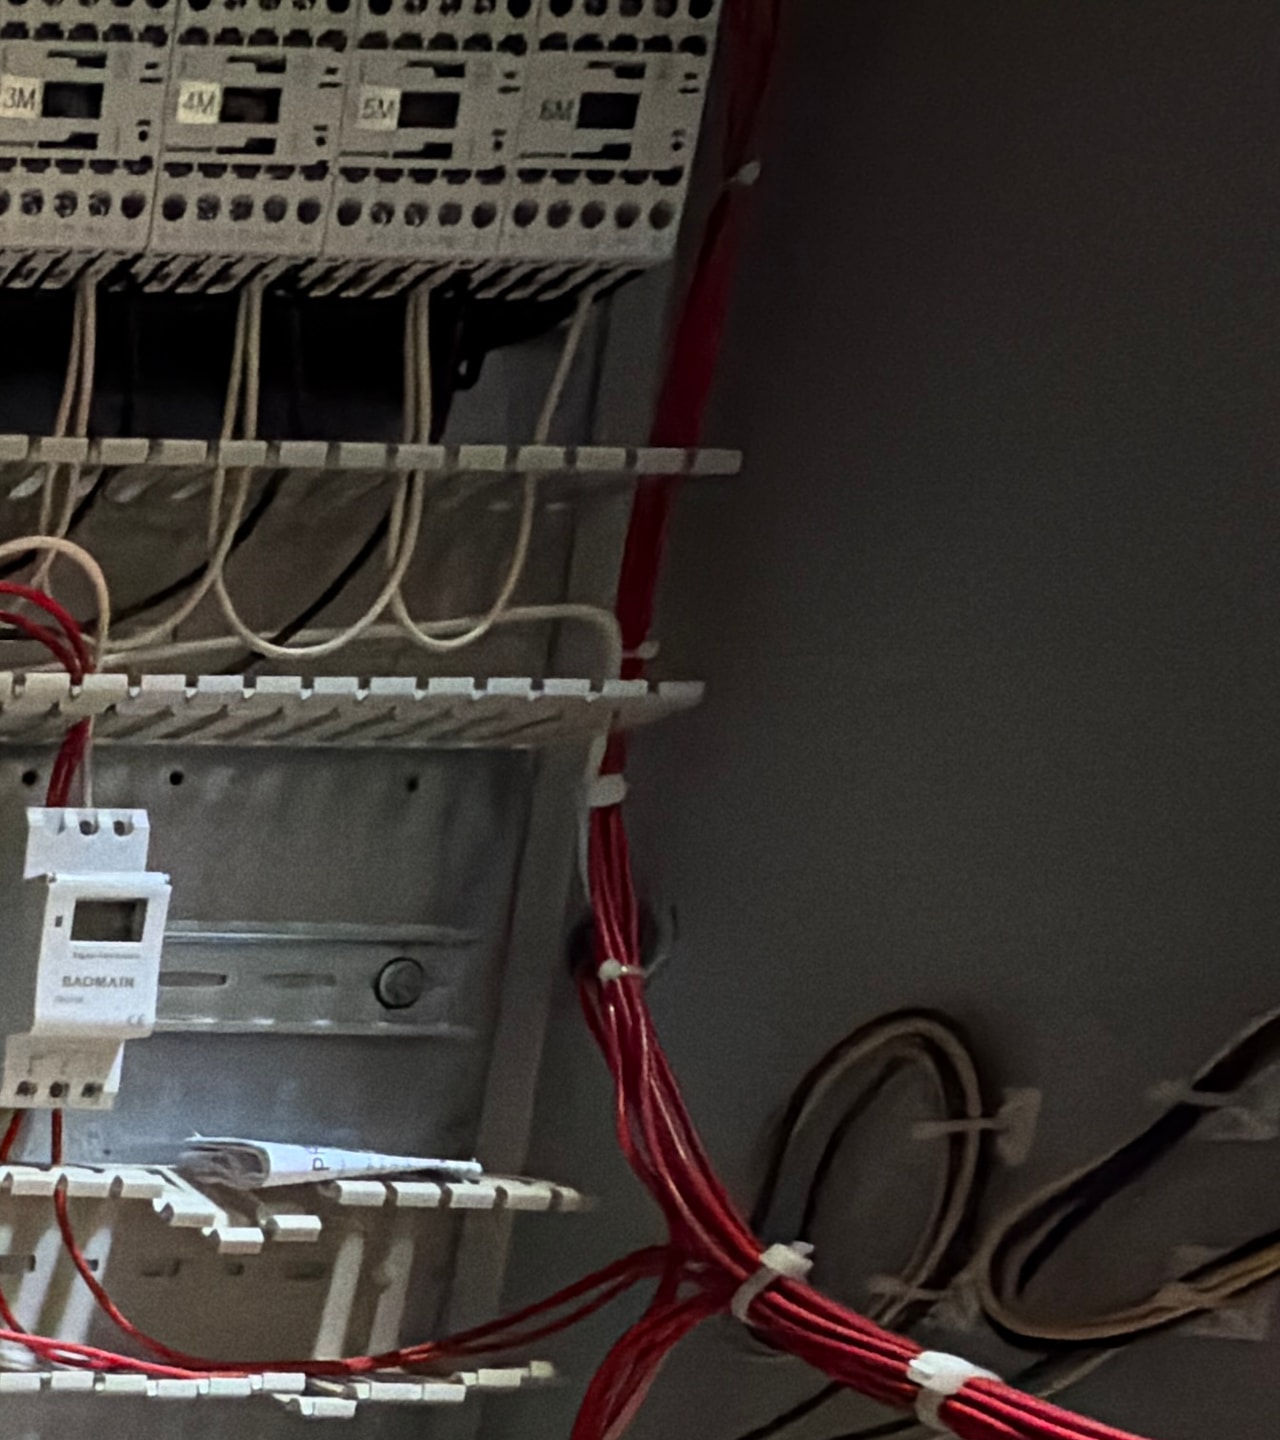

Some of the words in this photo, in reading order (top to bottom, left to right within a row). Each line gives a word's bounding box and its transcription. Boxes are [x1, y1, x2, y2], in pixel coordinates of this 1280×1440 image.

[1, 85, 37, 109] 3M
[181, 90, 216, 114] 4M
[362, 97, 396, 120] 5M
